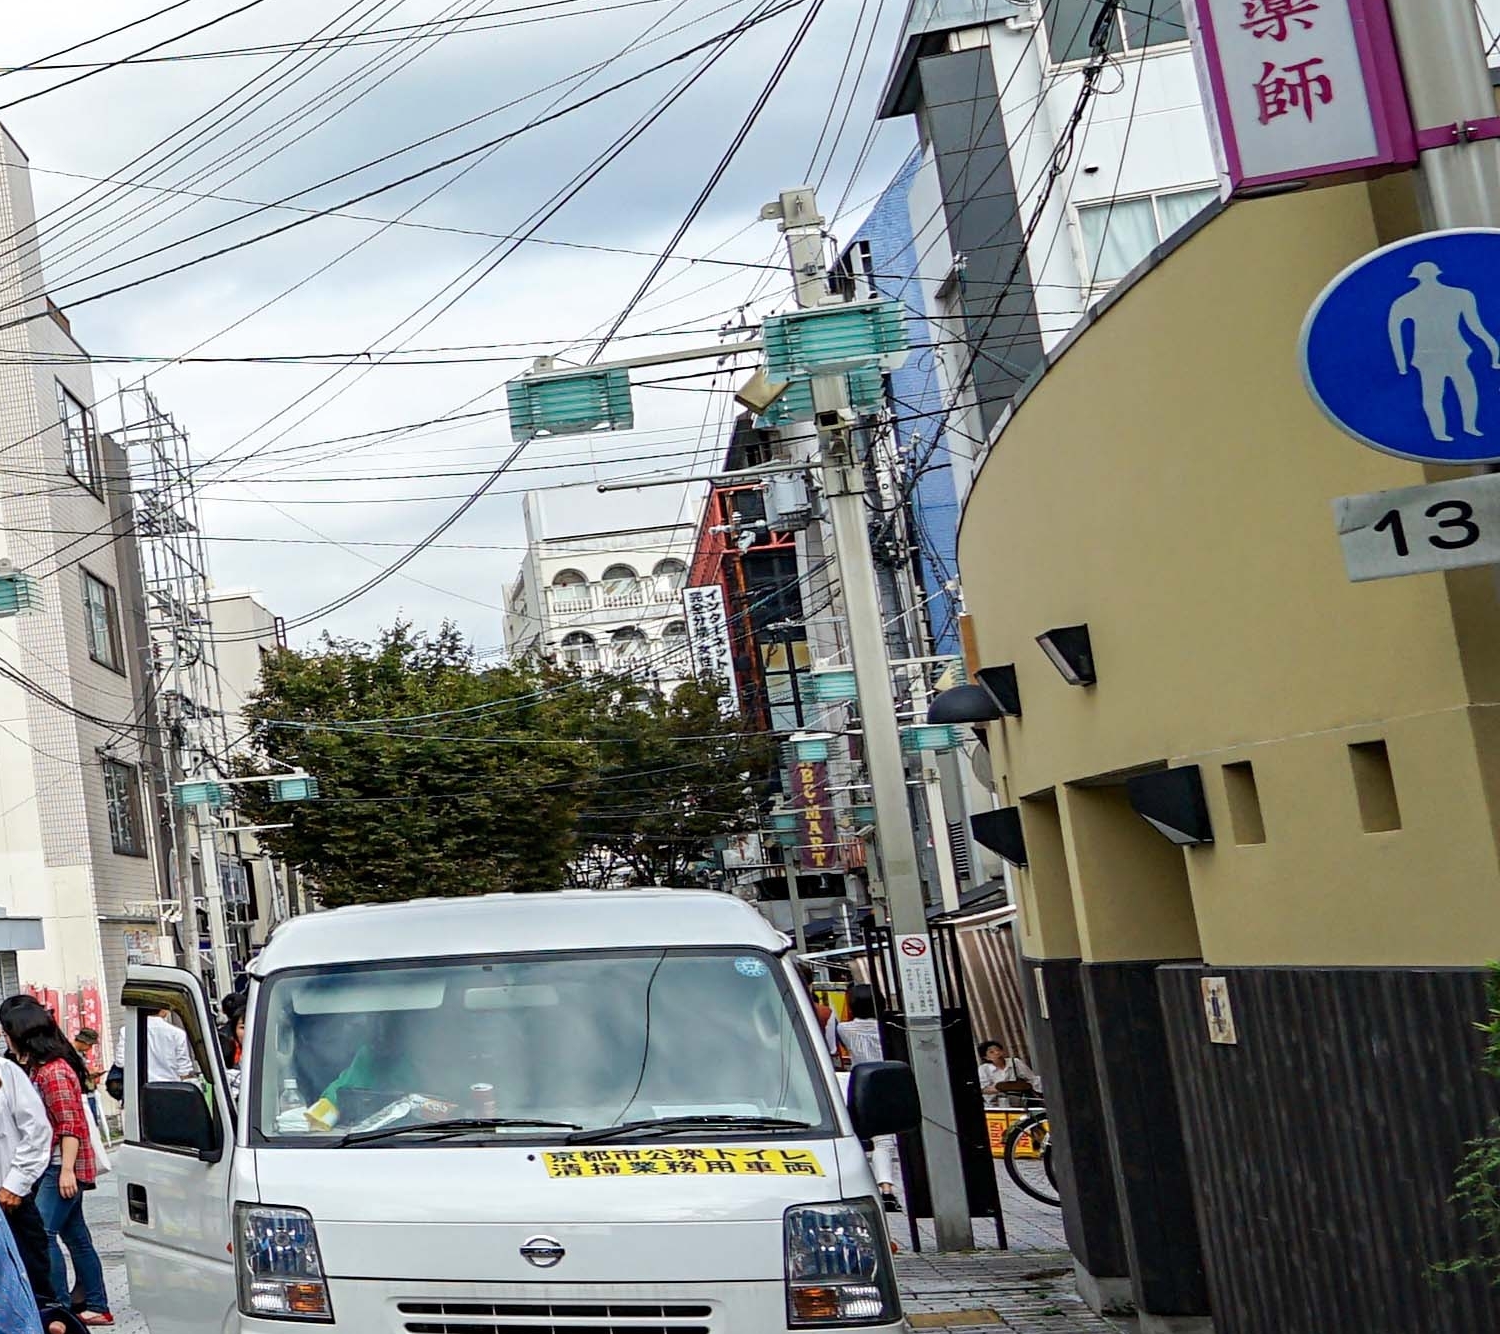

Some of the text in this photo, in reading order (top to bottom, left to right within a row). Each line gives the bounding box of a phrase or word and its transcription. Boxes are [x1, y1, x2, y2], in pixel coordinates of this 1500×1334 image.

[1372, 499, 1481, 557] 13
[549, 1148, 807, 1164] 京都市公衆トイレ
[552, 1161, 817, 1177] 清掃業務用車両
